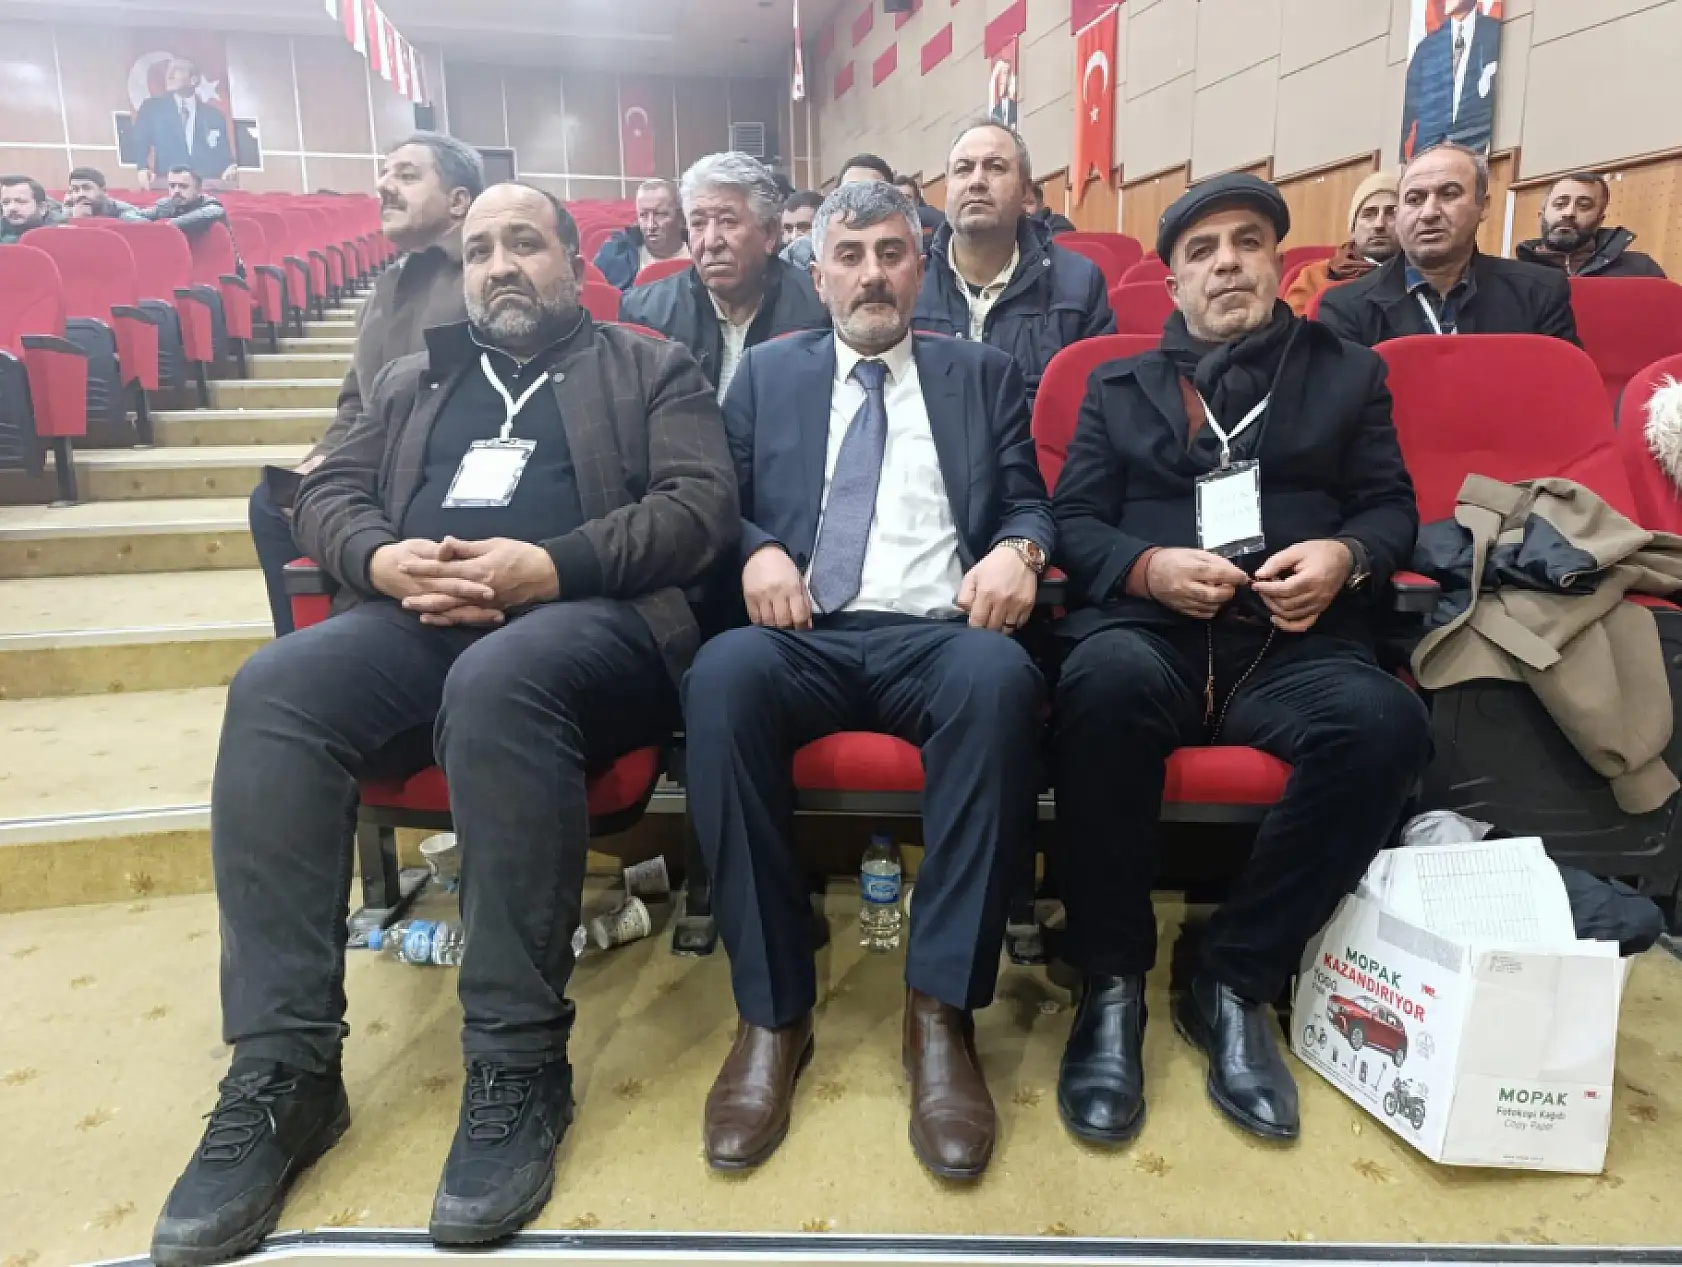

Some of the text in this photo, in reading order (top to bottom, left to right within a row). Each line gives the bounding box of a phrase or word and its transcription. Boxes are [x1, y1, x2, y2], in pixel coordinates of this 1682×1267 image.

[1346, 946, 1402, 989] MOPAK
[1323, 952, 1426, 1023] KAZANDIRIYOR
[1498, 1087, 1568, 1106] MOPAK
[1496, 1106, 1537, 1119] Fotokopi
[1504, 1118, 1528, 1131] Copy
